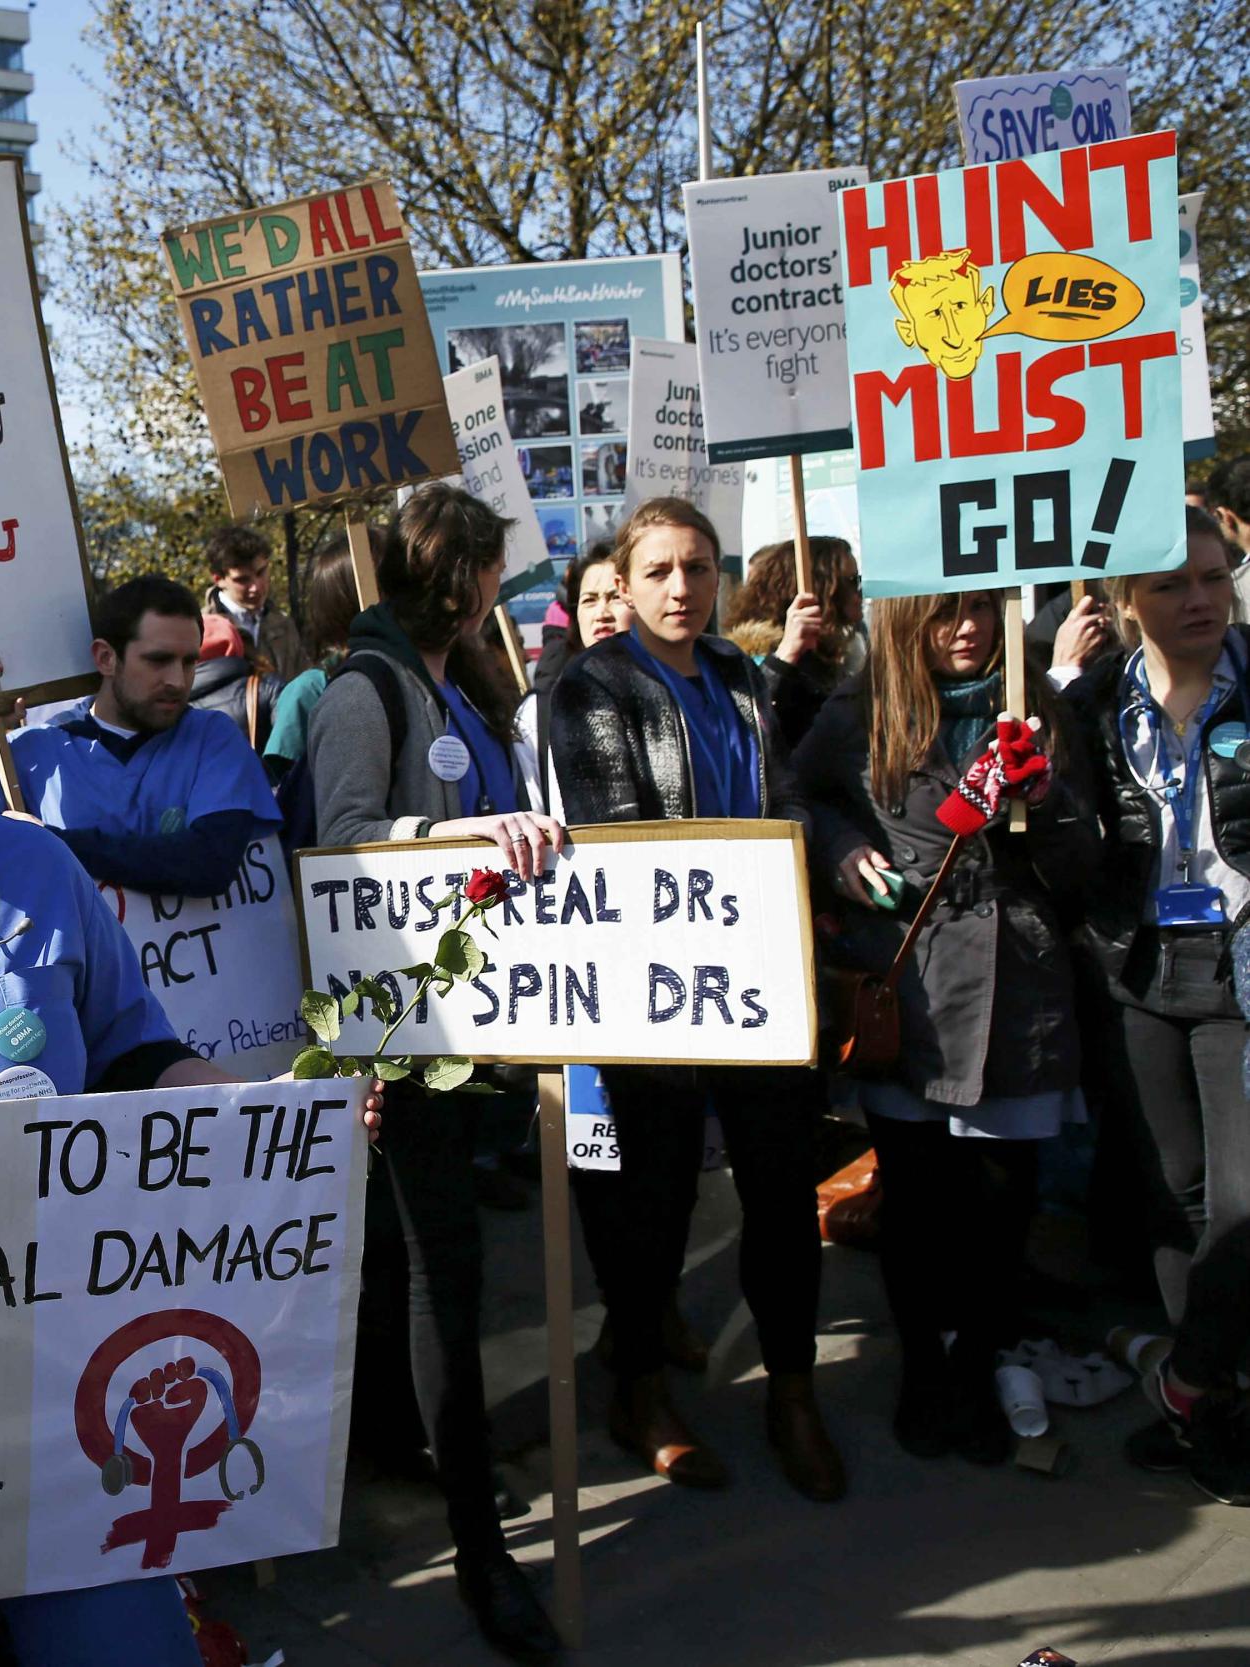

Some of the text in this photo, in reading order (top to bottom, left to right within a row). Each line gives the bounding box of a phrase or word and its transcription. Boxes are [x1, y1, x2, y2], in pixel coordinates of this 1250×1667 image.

[982, 98, 1117, 162] SAVE OUR
[165, 187, 403, 291] WE'D ALL
[741, 222, 822, 255] Junior
[843, 130, 1177, 288] HUNT
[189, 253, 402, 358] RATHER
[730, 282, 843, 315] contract
[1024, 275, 1118, 312] LIES
[230, 328, 405, 433] BE AT
[765, 352, 820, 384] fight
[854, 331, 1178, 471] MUST
[464, 404, 497, 431] one
[254, 409, 431, 506] WORK
[467, 461, 502, 496] tand
[939, 458, 1137, 578] GO!
[311, 867, 740, 933] TRUST REAL DRs
[471, 961, 601, 1027] SPIN
[648, 962, 769, 1029] DRs
[17, 1026, 33, 1042] BMA
[38, 1087, 54, 1097] NHS
[23, 1118, 109, 1200] TO
[137, 1106, 219, 1193] BE
[238, 1098, 348, 1183] THE
[572, 1143, 602, 1158] OR
[86, 1212, 338, 1298] DAMAGE
